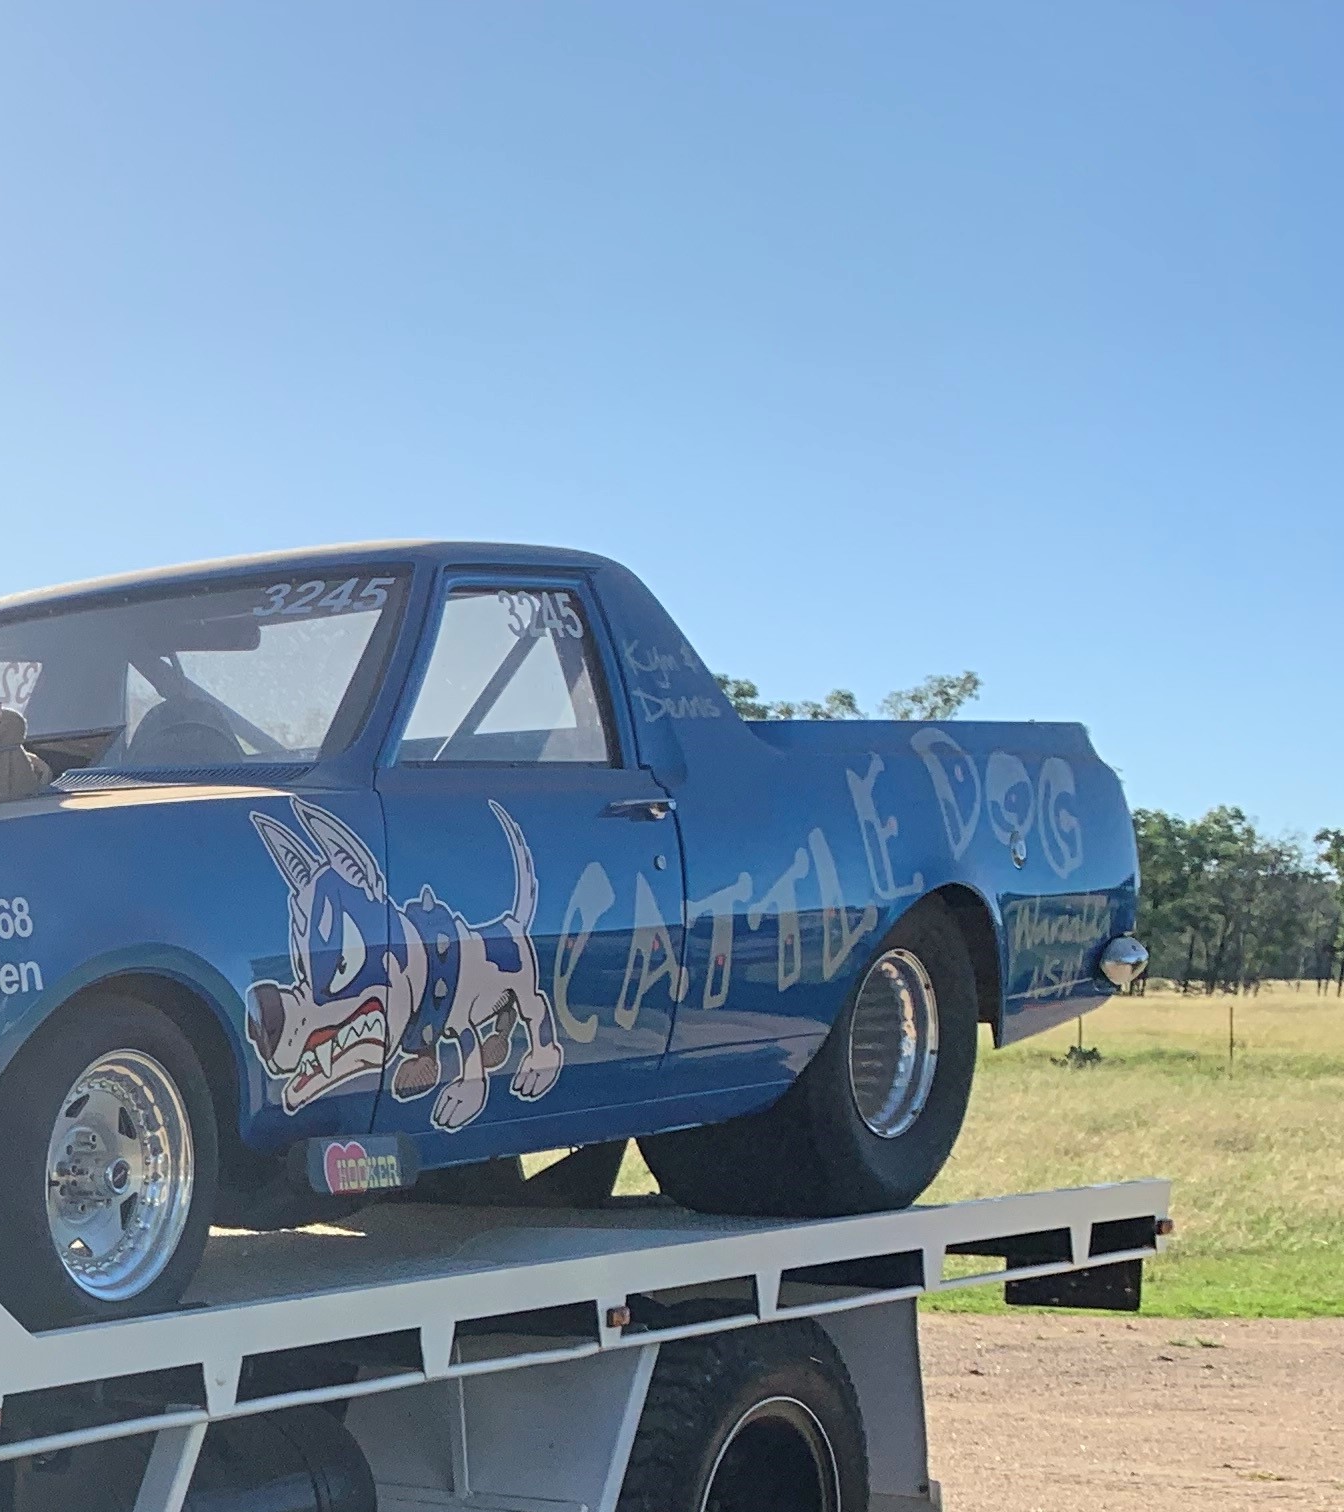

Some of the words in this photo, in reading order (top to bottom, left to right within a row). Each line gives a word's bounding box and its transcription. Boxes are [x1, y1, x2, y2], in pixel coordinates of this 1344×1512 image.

[253, 577, 396, 617] 3245
[498, 590, 584, 639] 3245
[554, 752, 923, 1044] CATTLE
[912, 727, 1084, 879] DOG
[336, 1155, 401, 1190] HOOKER
